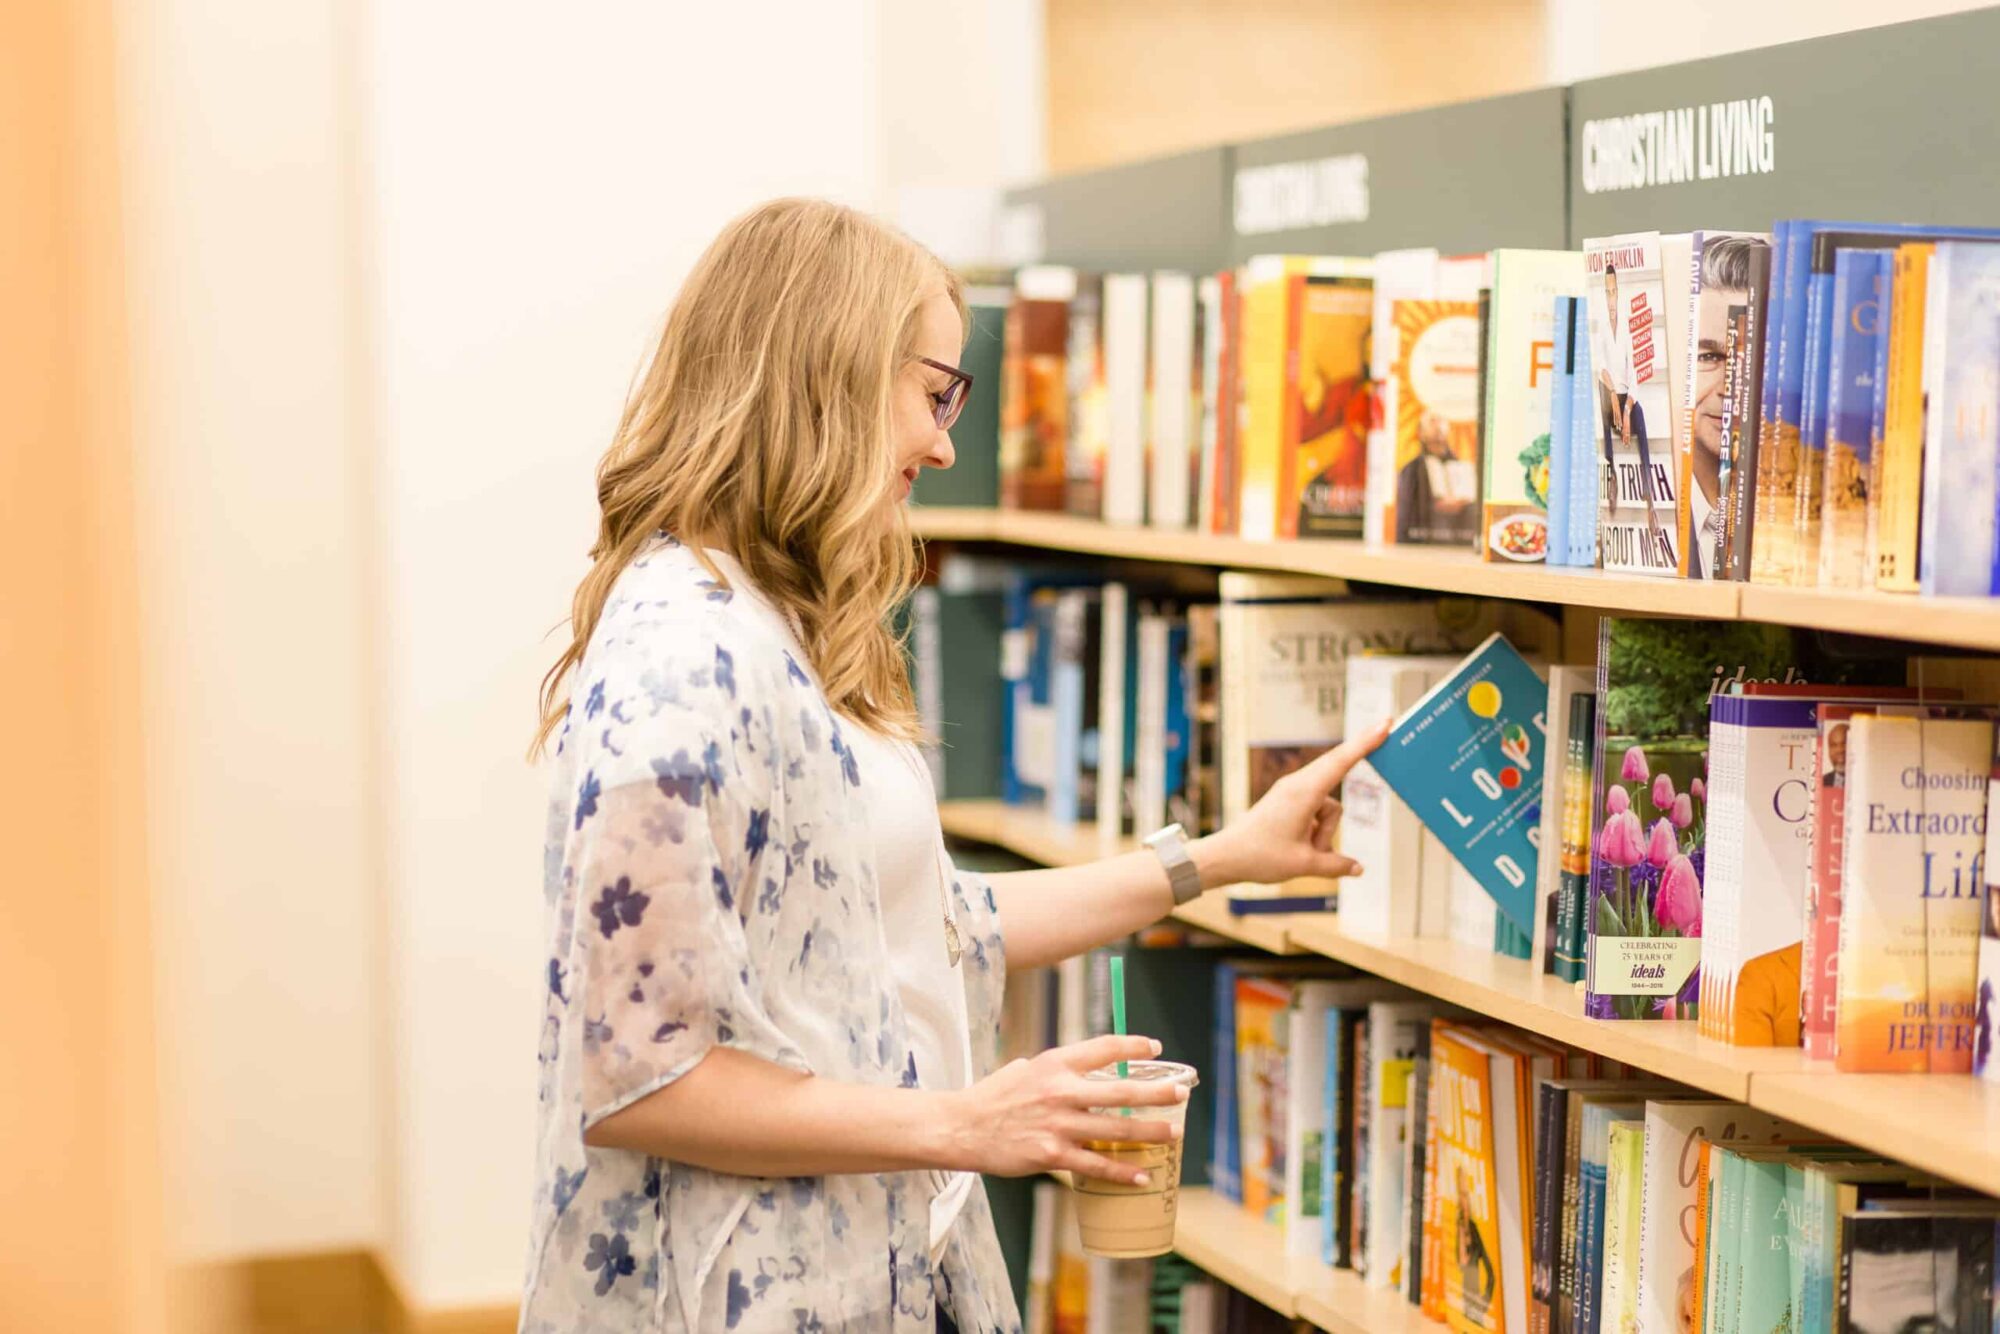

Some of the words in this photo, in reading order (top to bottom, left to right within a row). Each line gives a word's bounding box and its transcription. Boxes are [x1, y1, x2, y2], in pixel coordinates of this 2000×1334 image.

[1698, 96, 1774, 180] LIVING
[1605, 248, 1644, 270] FRANKLIN
[1724, 329, 1739, 395] fasting
[1742, 385, 1750, 423] THING
[1719, 398, 1732, 460] EDGE
[1619, 463, 1675, 502] TRUTH
[1736, 470, 1745, 525] FREEMAN
[1639, 527, 1678, 568] MEN
[1901, 766, 1985, 790] Choosin
[1867, 803, 1987, 835] Extraord
[1920, 850, 1984, 899] Lif
[1620, 942, 1677, 950] CELEBRATING
[1622, 952, 1631, 961] 75
[1633, 953, 1661, 961] YEARS
[1630, 964, 1665, 979] ideals
[1938, 1001, 1976, 1019] ROB
[1888, 1024, 1973, 1054] JEFFR
[1573, 1267, 1582, 1318] GOD
[1583, 1272, 1593, 1322] GOD
